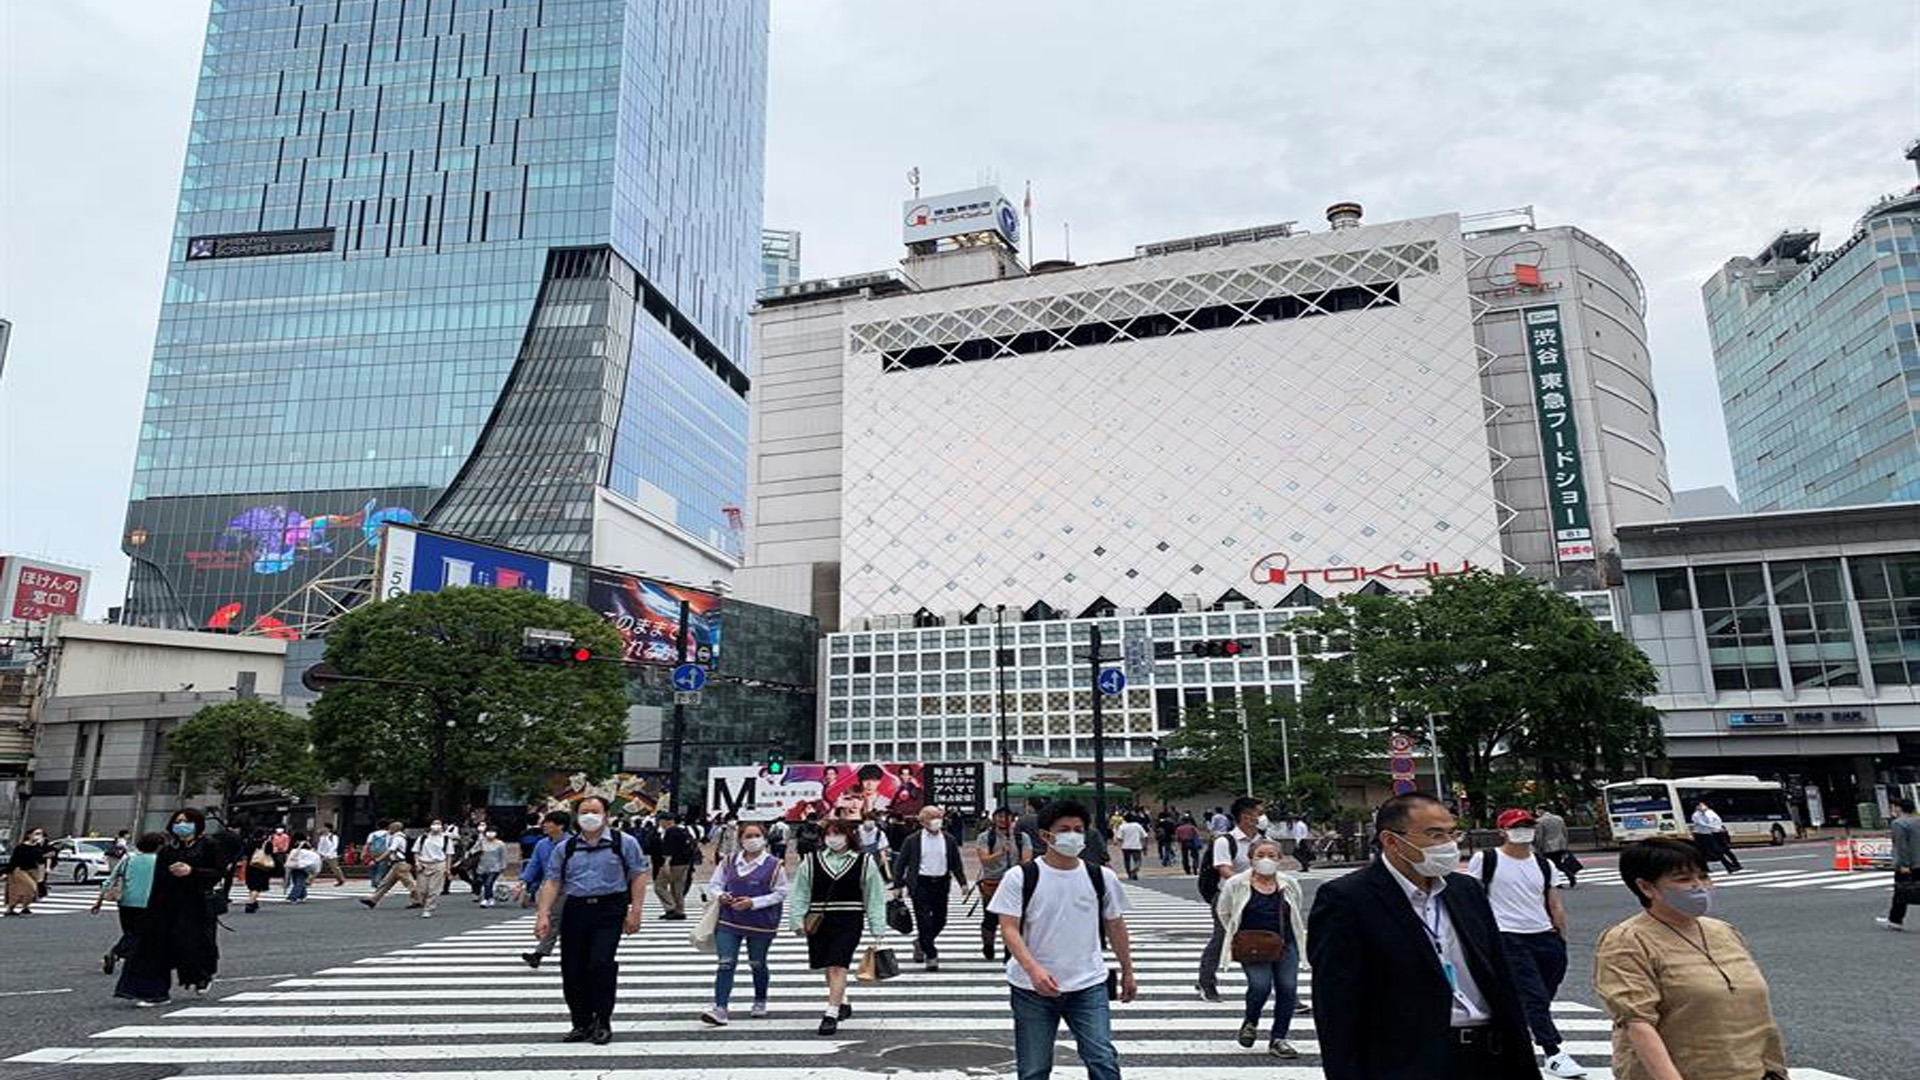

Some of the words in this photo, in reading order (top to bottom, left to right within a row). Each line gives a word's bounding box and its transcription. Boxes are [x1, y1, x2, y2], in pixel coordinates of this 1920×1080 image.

[1534, 328, 1559, 366] 渋谷
[1539, 372, 1580, 524] 東急フードショー
[20, 571, 79, 593] ほけんの
[1288, 560, 1472, 584] TOKYU
[713, 777, 756, 810] M
[933, 785, 975, 793] アベマで
